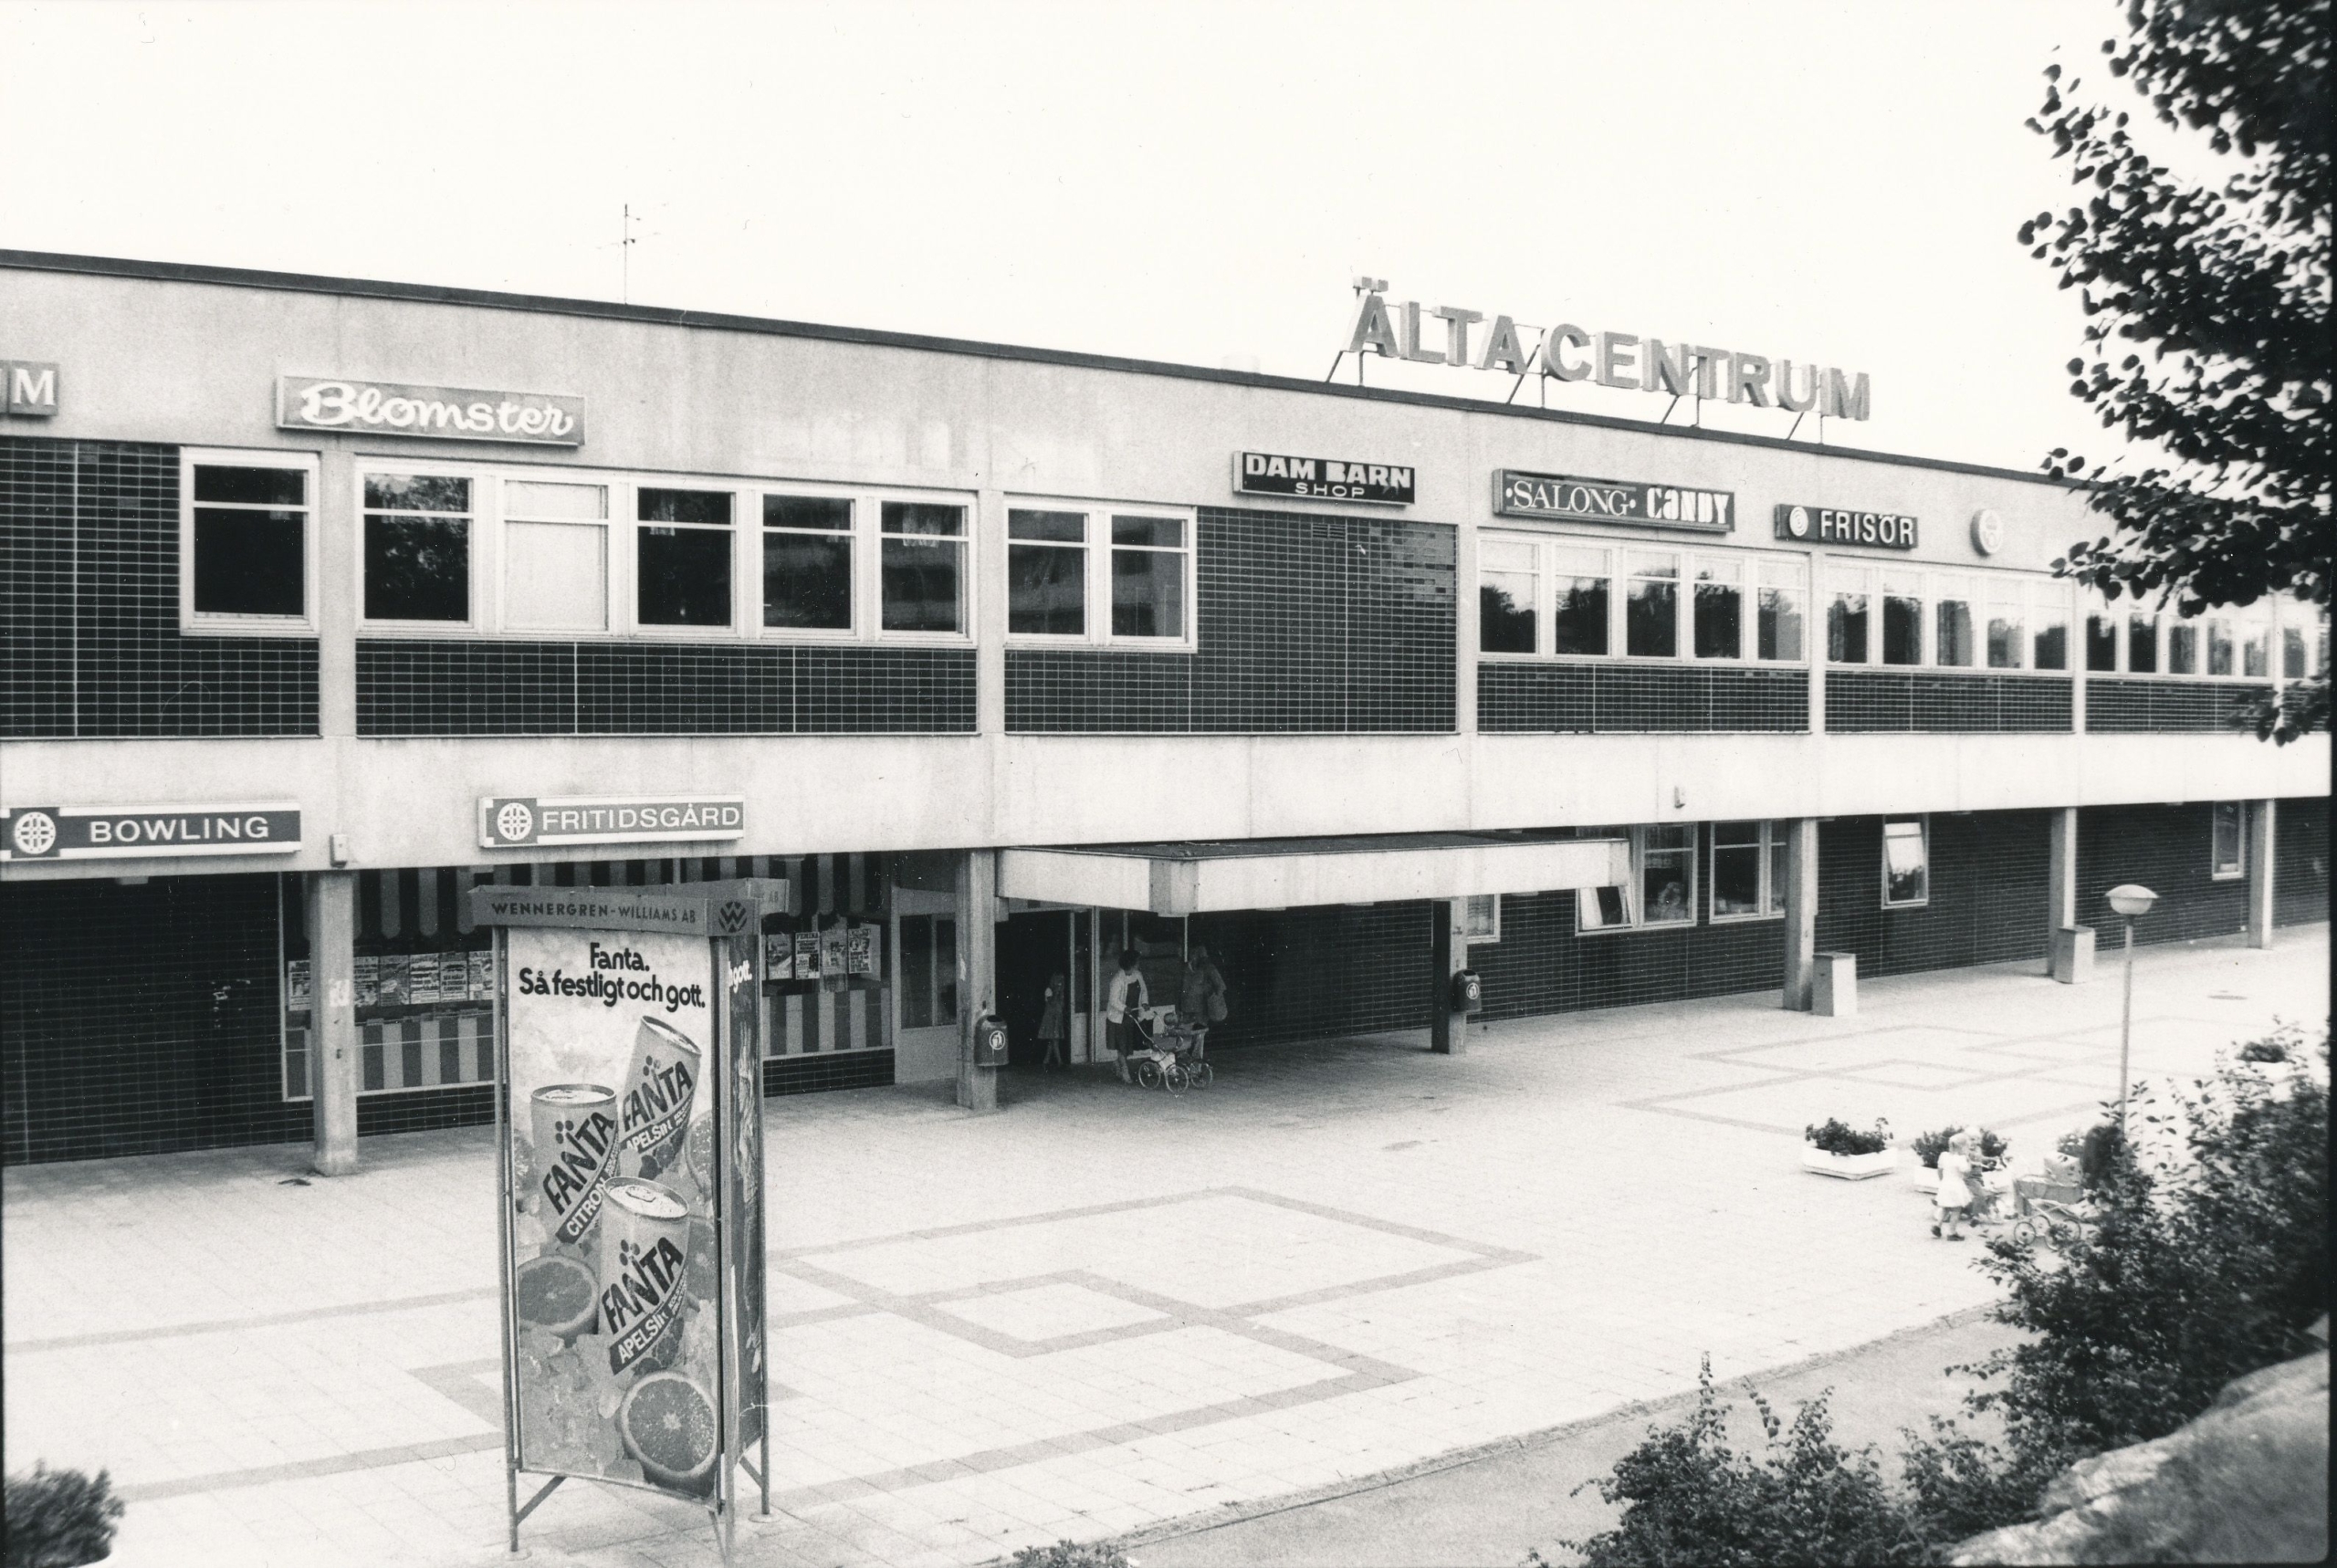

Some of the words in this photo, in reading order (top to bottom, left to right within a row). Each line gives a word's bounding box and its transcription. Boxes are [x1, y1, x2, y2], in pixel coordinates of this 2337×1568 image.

[1342, 277, 1526, 374] ÄLTA
[1540, 323, 1870, 422] CENTRUM
[299, 382, 574, 436] Blomster
[1245, 454, 1315, 481] DAM
[1326, 460, 1411, 489] BARN
[1294, 481, 1366, 498] SHOP
[1820, 509, 1914, 545] FRISÖR
[89, 816, 269, 842] BOWLING
[542, 803, 740, 831] FRITIDSGÅRD
[681, 909, 697, 924] AB
[589, 942, 650, 971] Fanta.
[519, 967, 550, 995] Så
[551, 969, 624, 1007] festligt
[626, 974, 663, 1001] och
[665, 984, 707, 1013] gott.
[623, 1061, 693, 1133] FANTA
[542, 1112, 617, 1216] FANTA
[566, 1176, 606, 1236] CITRON
[602, 1237, 685, 1334] FANTA
